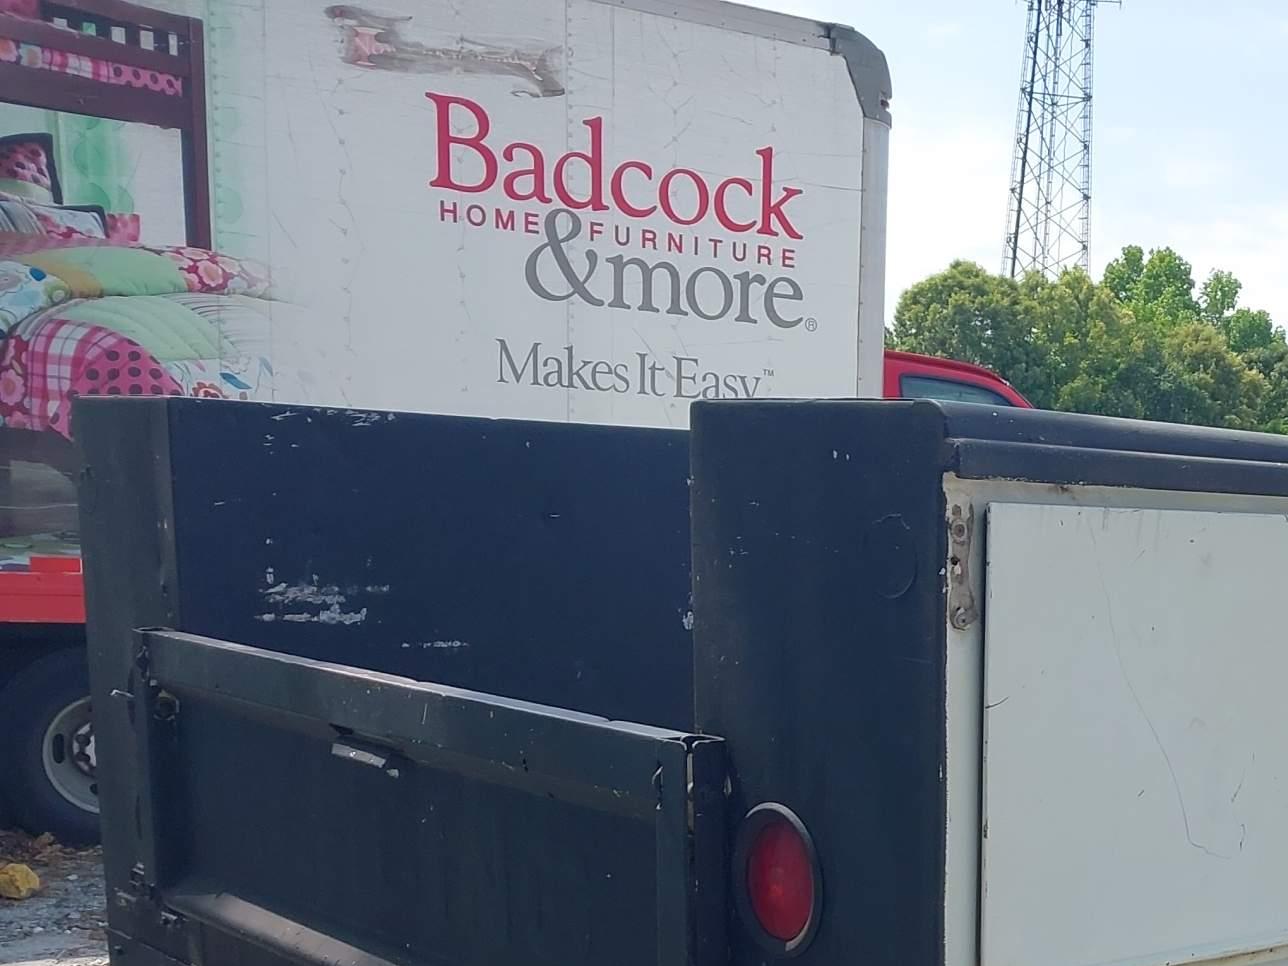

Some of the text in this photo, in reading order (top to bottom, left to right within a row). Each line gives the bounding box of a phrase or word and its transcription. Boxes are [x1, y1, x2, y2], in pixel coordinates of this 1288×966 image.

[424, 91, 804, 240] Badcock
[439, 199, 796, 269] HOME FURNITURE
[495, 337, 630, 394] Makes
[635, 352, 666, 397] It
